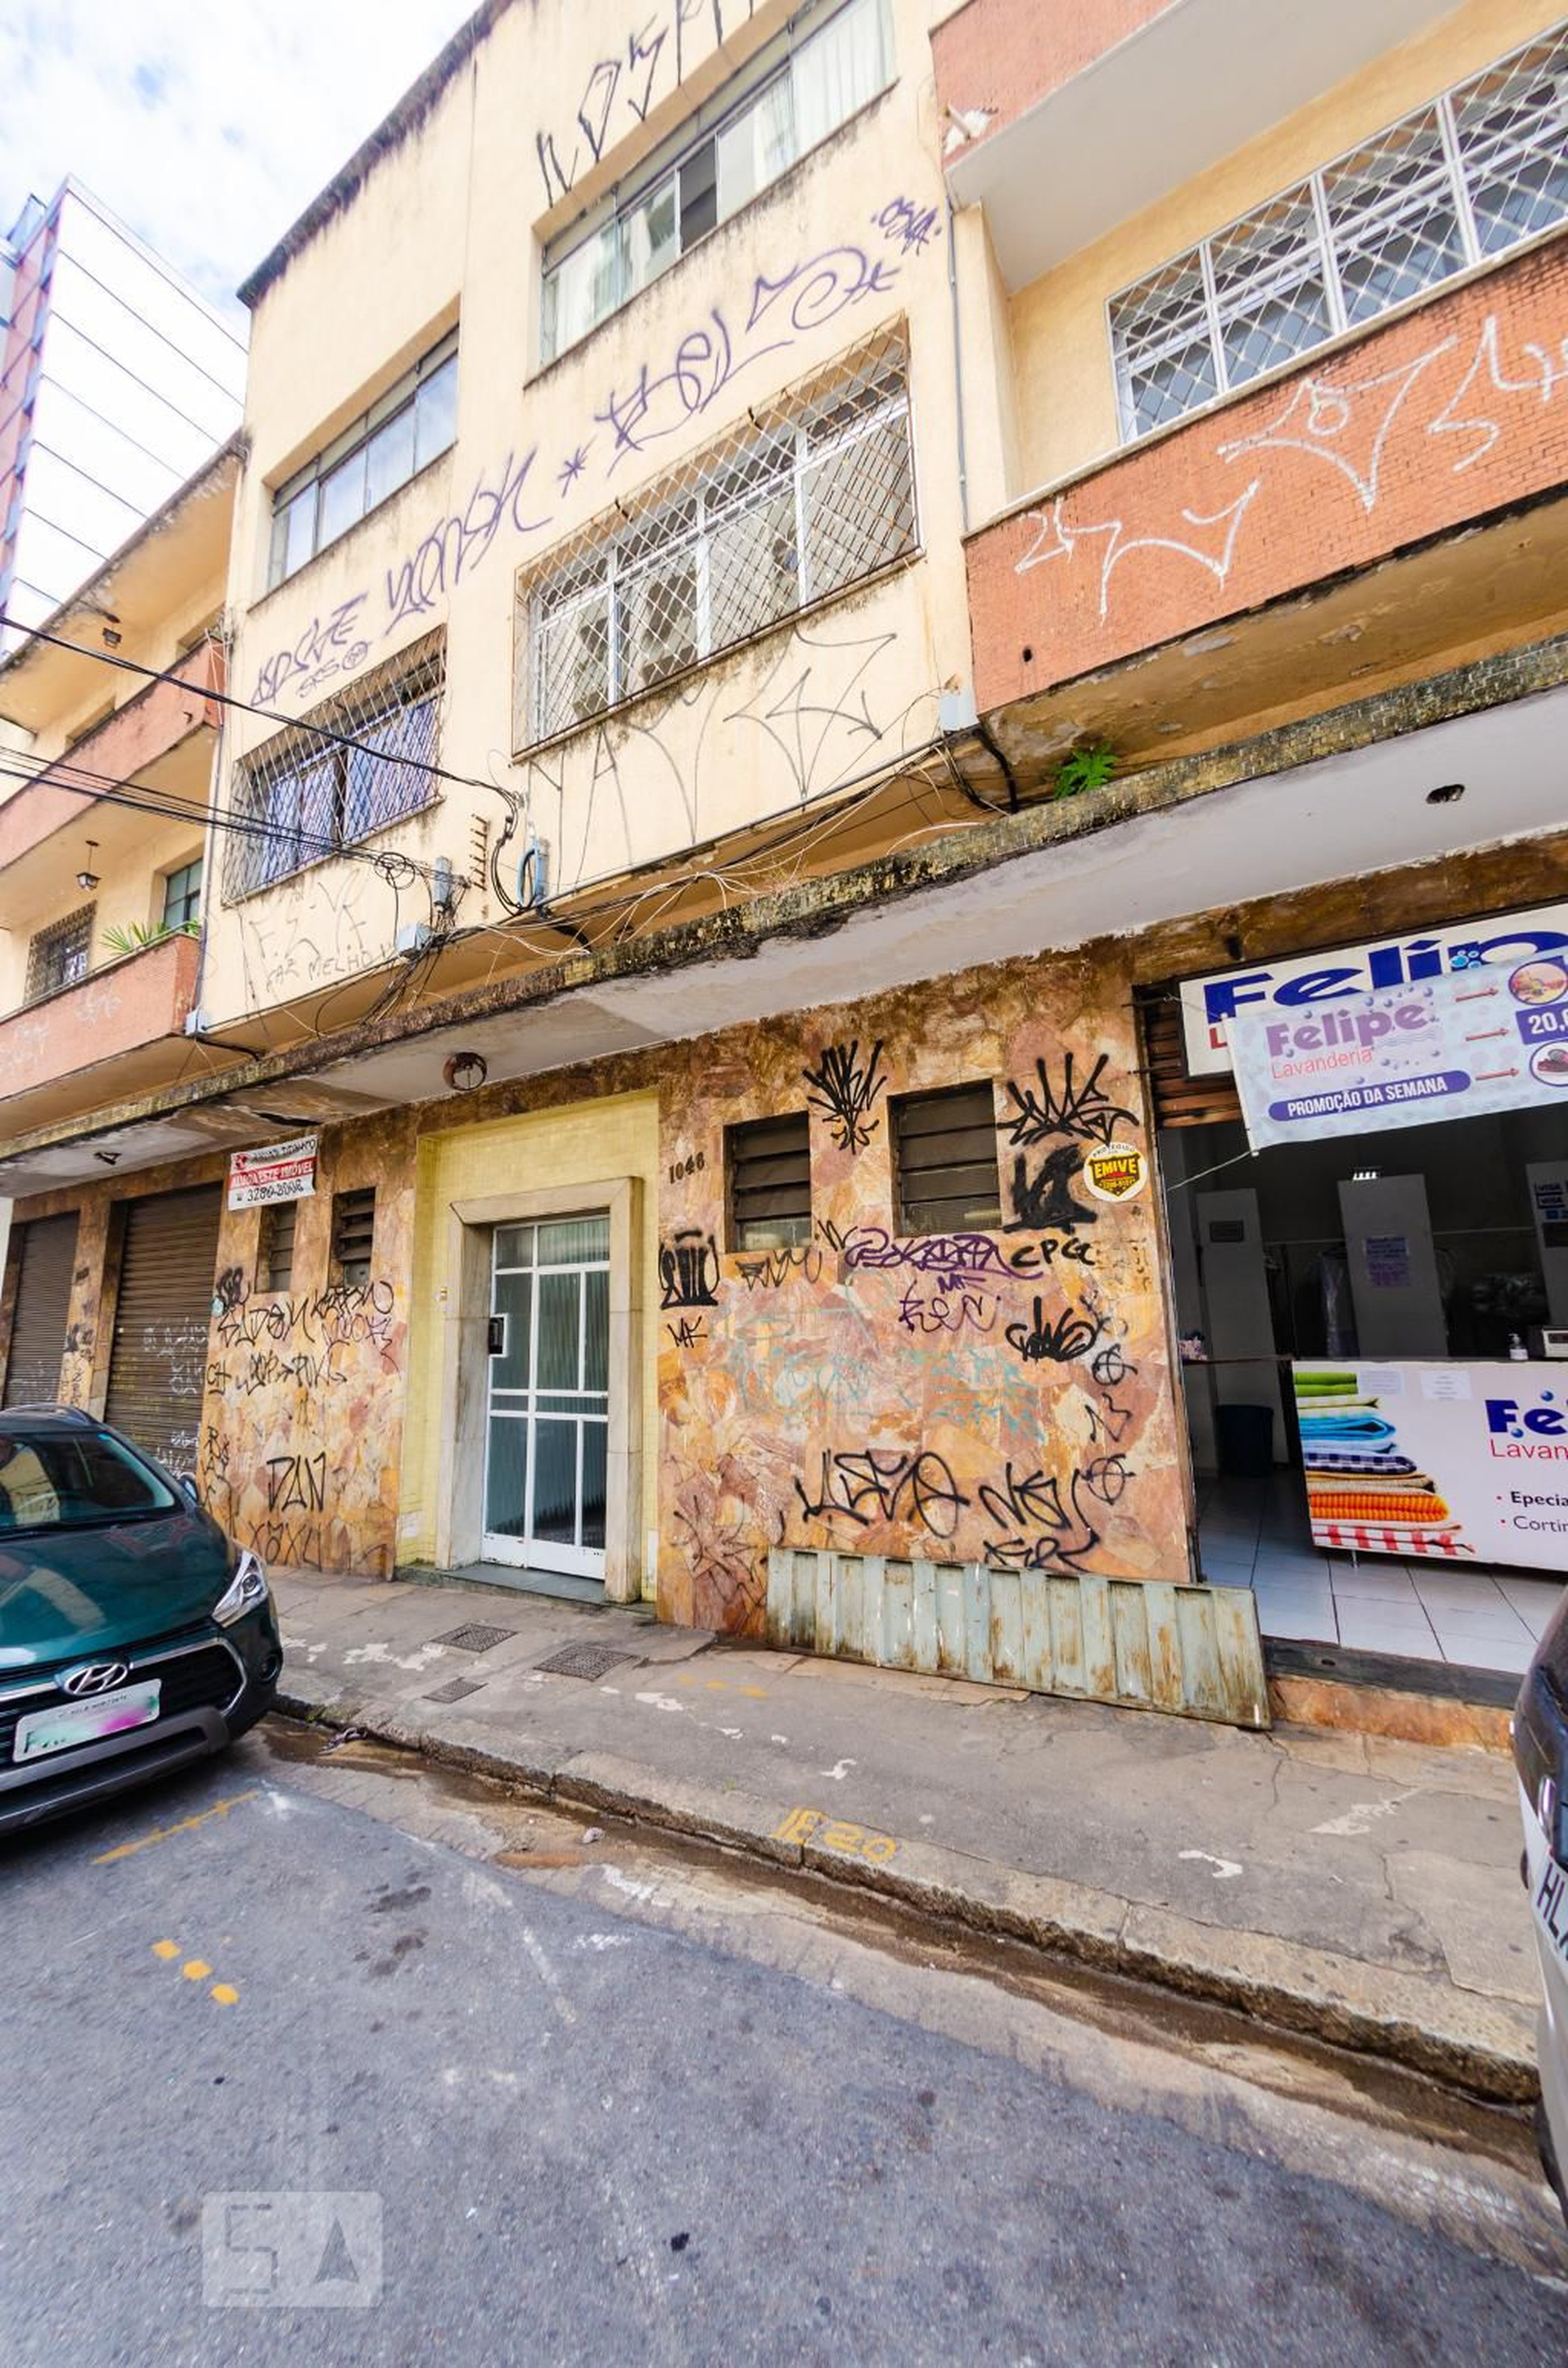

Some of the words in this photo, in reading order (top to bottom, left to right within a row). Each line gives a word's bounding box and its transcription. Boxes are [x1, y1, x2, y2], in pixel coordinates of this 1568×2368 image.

[1266, 1004, 1429, 1057] Felipe
[1271, 1048, 1373, 1079] Lavanderia
[1287, 1088, 1361, 1118] PROMOÇÃO
[1363, 1089, 1384, 1104] DA
[1388, 1076, 1448, 1102] SEMANA
[668, 1151, 705, 1184] 1048
[1095, 1157, 1137, 1179] EMIVE
[1485, 1400, 1568, 1436] Fe
